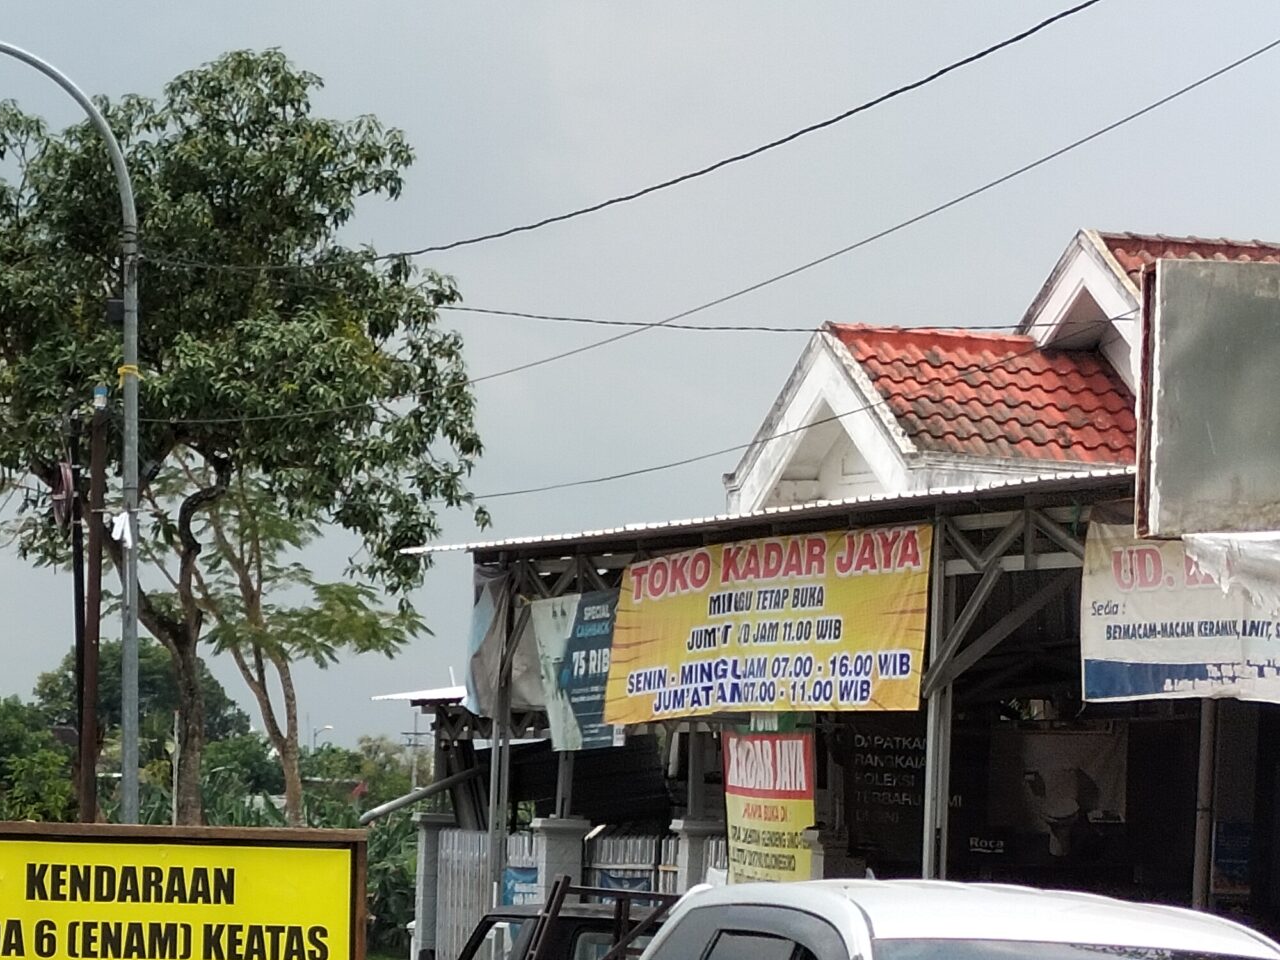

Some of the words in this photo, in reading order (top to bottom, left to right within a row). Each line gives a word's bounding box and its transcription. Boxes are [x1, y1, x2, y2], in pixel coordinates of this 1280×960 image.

[631, 551, 712, 600] TOKO
[721, 537, 827, 583] KADAR
[836, 529, 920, 574] JAYA
[1111, 547, 1175, 590] UD.
[756, 588, 790, 610] TETAP
[792, 586, 825, 608] BUKA
[1091, 601, 1119, 616] Sedia
[753, 622, 780, 643] JAM
[783, 620, 812, 641] 11.00
[816, 619, 842, 640] WIB
[572, 651, 585, 676] 75
[627, 669, 667, 694] SENIN
[771, 656, 812, 679] 07.00
[829, 655, 871, 676] 16.00
[878, 653, 911, 676] WIB
[654, 686, 713, 712] JUM'AT
[790, 680, 832, 703] 11.00
[838, 680, 871, 700] WIB
[776, 740, 806, 791] JAYA
[969, 836, 1004, 848] Roca
[26, 863, 235, 905] KENDARAAN
[35, 920, 56, 958] 6
[67, 921, 191, 960] (ENAM)
